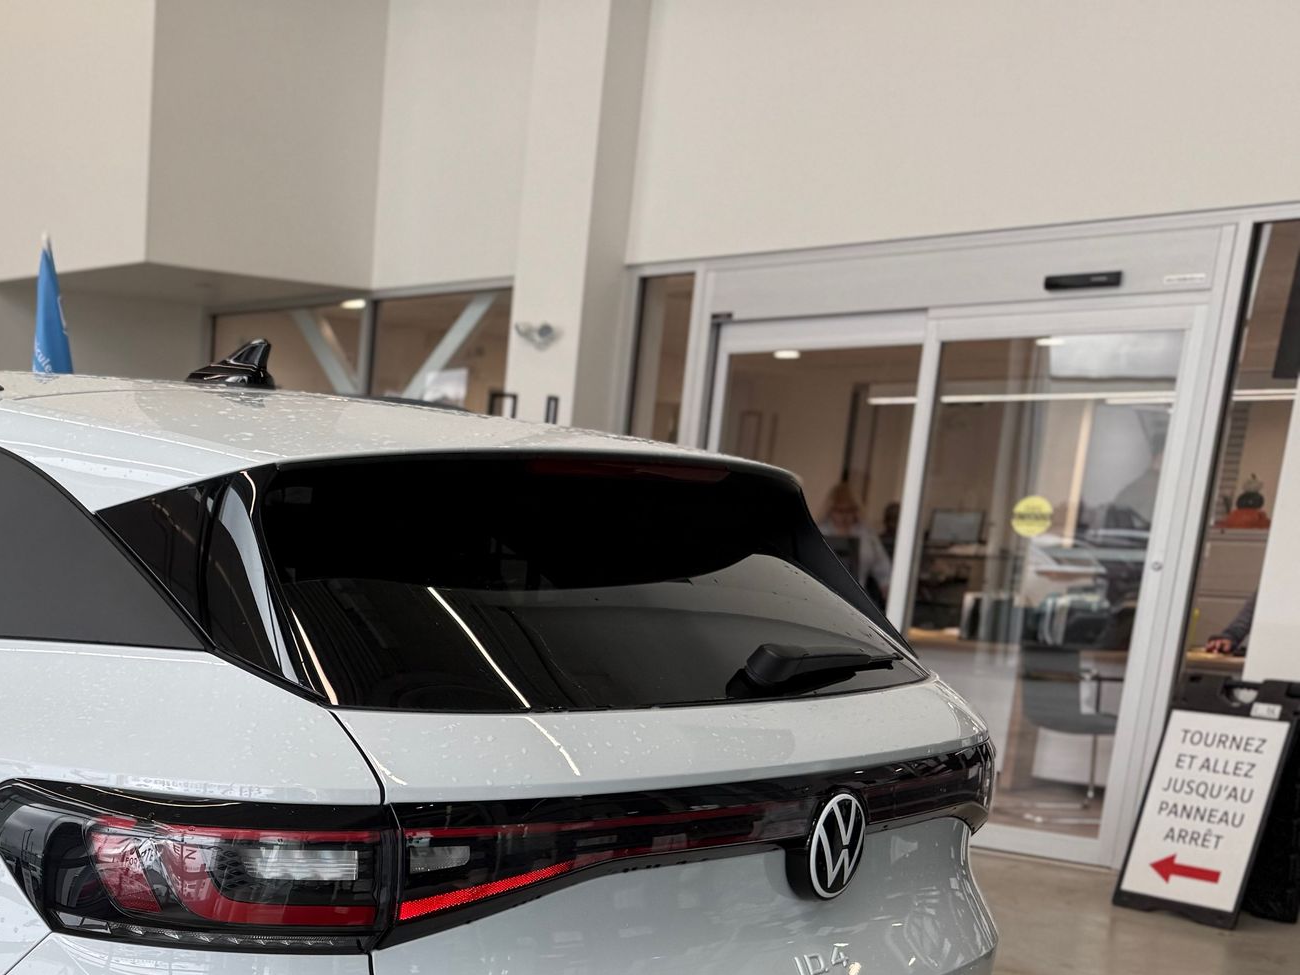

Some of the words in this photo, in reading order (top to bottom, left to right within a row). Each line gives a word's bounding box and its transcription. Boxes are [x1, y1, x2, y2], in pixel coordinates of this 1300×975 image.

[1180, 729, 1268, 754] TOURNEZ
[1174, 754, 1198, 770] ET
[1198, 757, 1257, 779] ALLEZ
[1161, 776, 1255, 804] JUSQU'AU
[1157, 801, 1245, 829] PANNEAU
[1163, 827, 1225, 850] ARRÊT
